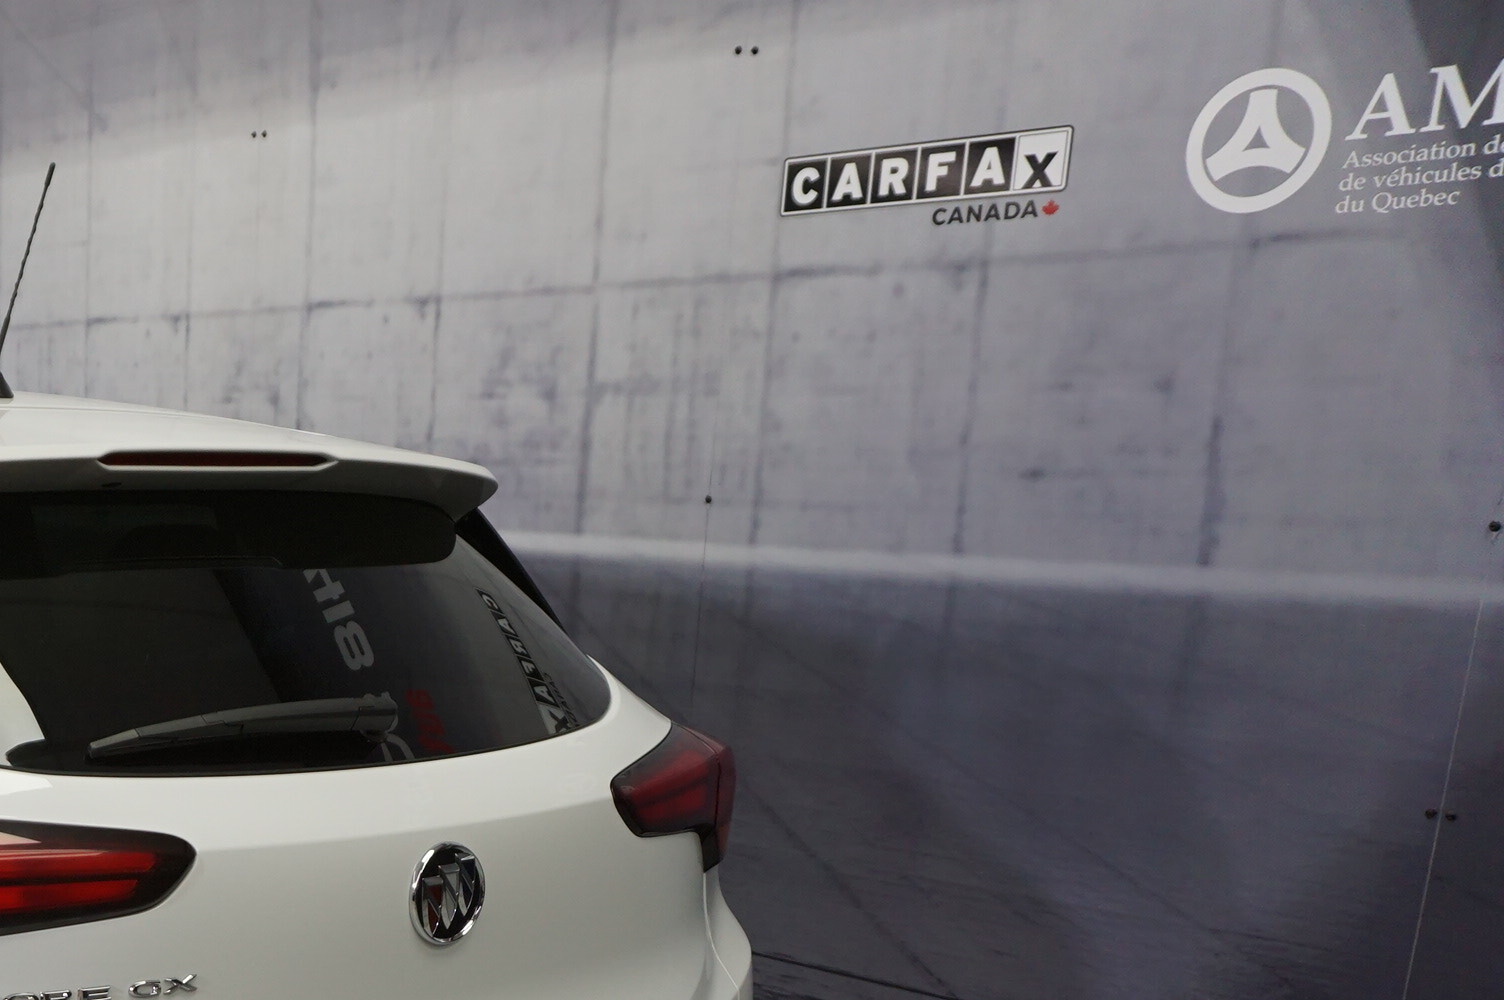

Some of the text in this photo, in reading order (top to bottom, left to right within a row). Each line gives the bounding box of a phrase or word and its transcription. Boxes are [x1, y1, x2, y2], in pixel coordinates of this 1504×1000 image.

[1341, 140, 1477, 169] Association
[791, 145, 1059, 206] CARFAX
[1338, 172, 1367, 191] de
[1373, 162, 1482, 188] véhicules
[932, 201, 1040, 228] CANADA
[1334, 188, 1461, 214] du Quebec
[127, 973, 199, 1000] GX
